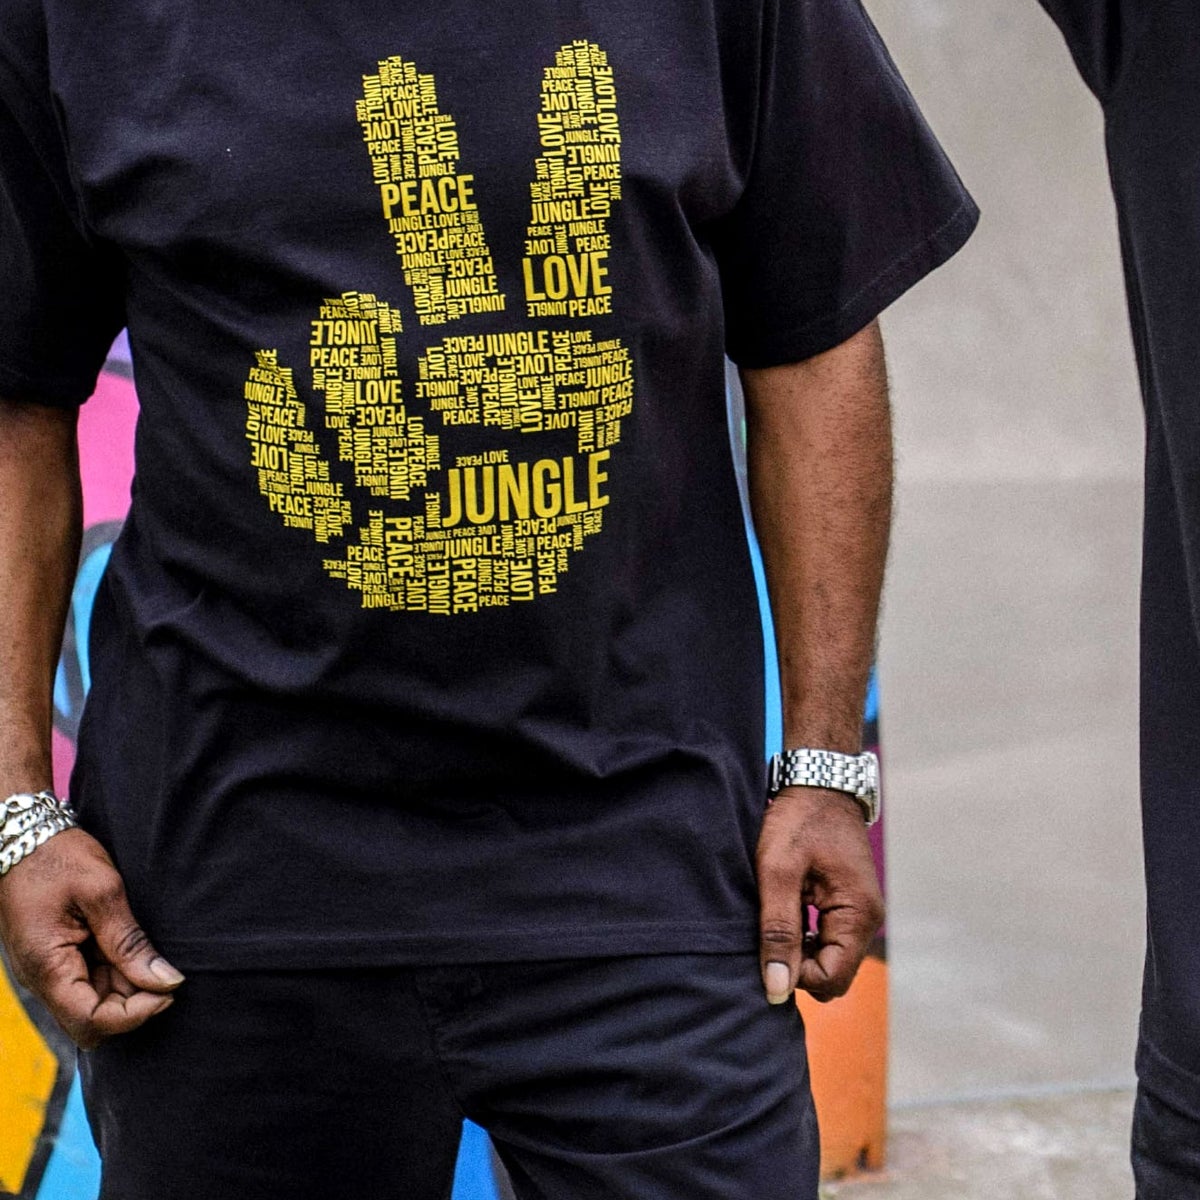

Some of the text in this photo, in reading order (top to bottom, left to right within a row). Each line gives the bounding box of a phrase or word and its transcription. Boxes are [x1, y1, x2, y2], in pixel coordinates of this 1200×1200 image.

[362, 74, 385, 121] JUNGLE
[382, 84, 420, 102] PEACE
[418, 74, 438, 115] JUNGLE
[593, 66, 617, 104] LOVE
[385, 99, 422, 120] LOVE
[540, 92, 578, 111] LOVE
[574, 78, 598, 125] JUNGLE
[361, 120, 400, 141] LOVE
[537, 112, 567, 157] LOVE
[596, 104, 621, 143] LOVE
[368, 139, 402, 155] PEACE
[413, 116, 438, 165] PEACE
[435, 122, 460, 161] LOVE
[566, 144, 620, 165] JUNGLE
[372, 155, 390, 184] LOVE
[418, 162, 456, 178] JUNGLE
[583, 164, 622, 180] PEACE
[565, 167, 584, 199] LOVE
[380, 174, 477, 219] PEACE
[589, 182, 611, 218] LOVE
[388, 214, 433, 234] JUNGLE
[433, 212, 461, 229] LOVE
[530, 199, 592, 225] JUNGLE
[448, 232, 486, 249] PEACE
[568, 219, 606, 237] JUNGLE
[394, 229, 449, 255] PEACE
[524, 239, 555, 255] LOVE
[575, 235, 612, 253] PEACE
[401, 250, 446, 270] JUNGLE
[446, 256, 494, 278] PEACE
[445, 275, 499, 298] JUNGLE
[522, 251, 613, 301] LOVE
[413, 284, 431, 314] LOVE
[458, 294, 506, 315] JUNGLE
[527, 301, 567, 317] JUNGLE
[569, 296, 613, 318] PEACE
[310, 320, 377, 345] JUNGLE
[442, 335, 484, 354] PEACE
[484, 330, 550, 357] JUNGLE
[310, 347, 359, 367] PEACE
[426, 346, 447, 379] LOVE
[458, 353, 486, 368] LOVE
[552, 330, 572, 372] PEACE
[459, 367, 498, 385] PEACE
[516, 354, 553, 375] LOVE
[585, 360, 633, 388] JUNGLE
[325, 367, 343, 415] JUNGLE
[355, 379, 402, 405] LOVE
[415, 380, 459, 398] JUNGLE
[497, 357, 518, 407] JUNGLE
[601, 379, 634, 404] PEACE
[481, 384, 500, 426] PEACE
[519, 388, 543, 433] LOVE
[558, 389, 600, 409] JUNGLE
[260, 405, 296, 428] PEACE
[325, 415, 350, 429] LOVE
[355, 405, 405, 426] PEACE
[443, 409, 480, 425] PEACE
[544, 411, 576, 430] LOVE
[260, 423, 288, 446] LOVE
[407, 416, 425, 446] LOVE
[250, 442, 288, 472] LOVE
[353, 428, 372, 475] JUNGLE
[372, 438, 388, 475] PEACE
[388, 448, 410, 501] JUNGLE
[408, 446, 427, 488] PEACE
[442, 450, 611, 528] JUNGLE
[269, 494, 313, 517] PEACE
[514, 517, 557, 537] PEACE
[385, 516, 415, 578] PEACE
[443, 535, 502, 560] JUNGLE
[536, 532, 573, 550] PEACE
[347, 545, 386, 563] PEACE
[510, 558, 534, 601] LOVE
[539, 550, 557, 595] PEACE
[406, 577, 427, 611] LOVE
[427, 560, 451, 616] JUNGLE
[452, 558, 478, 615] PEACE
[361, 592, 405, 609] JUNGLE
